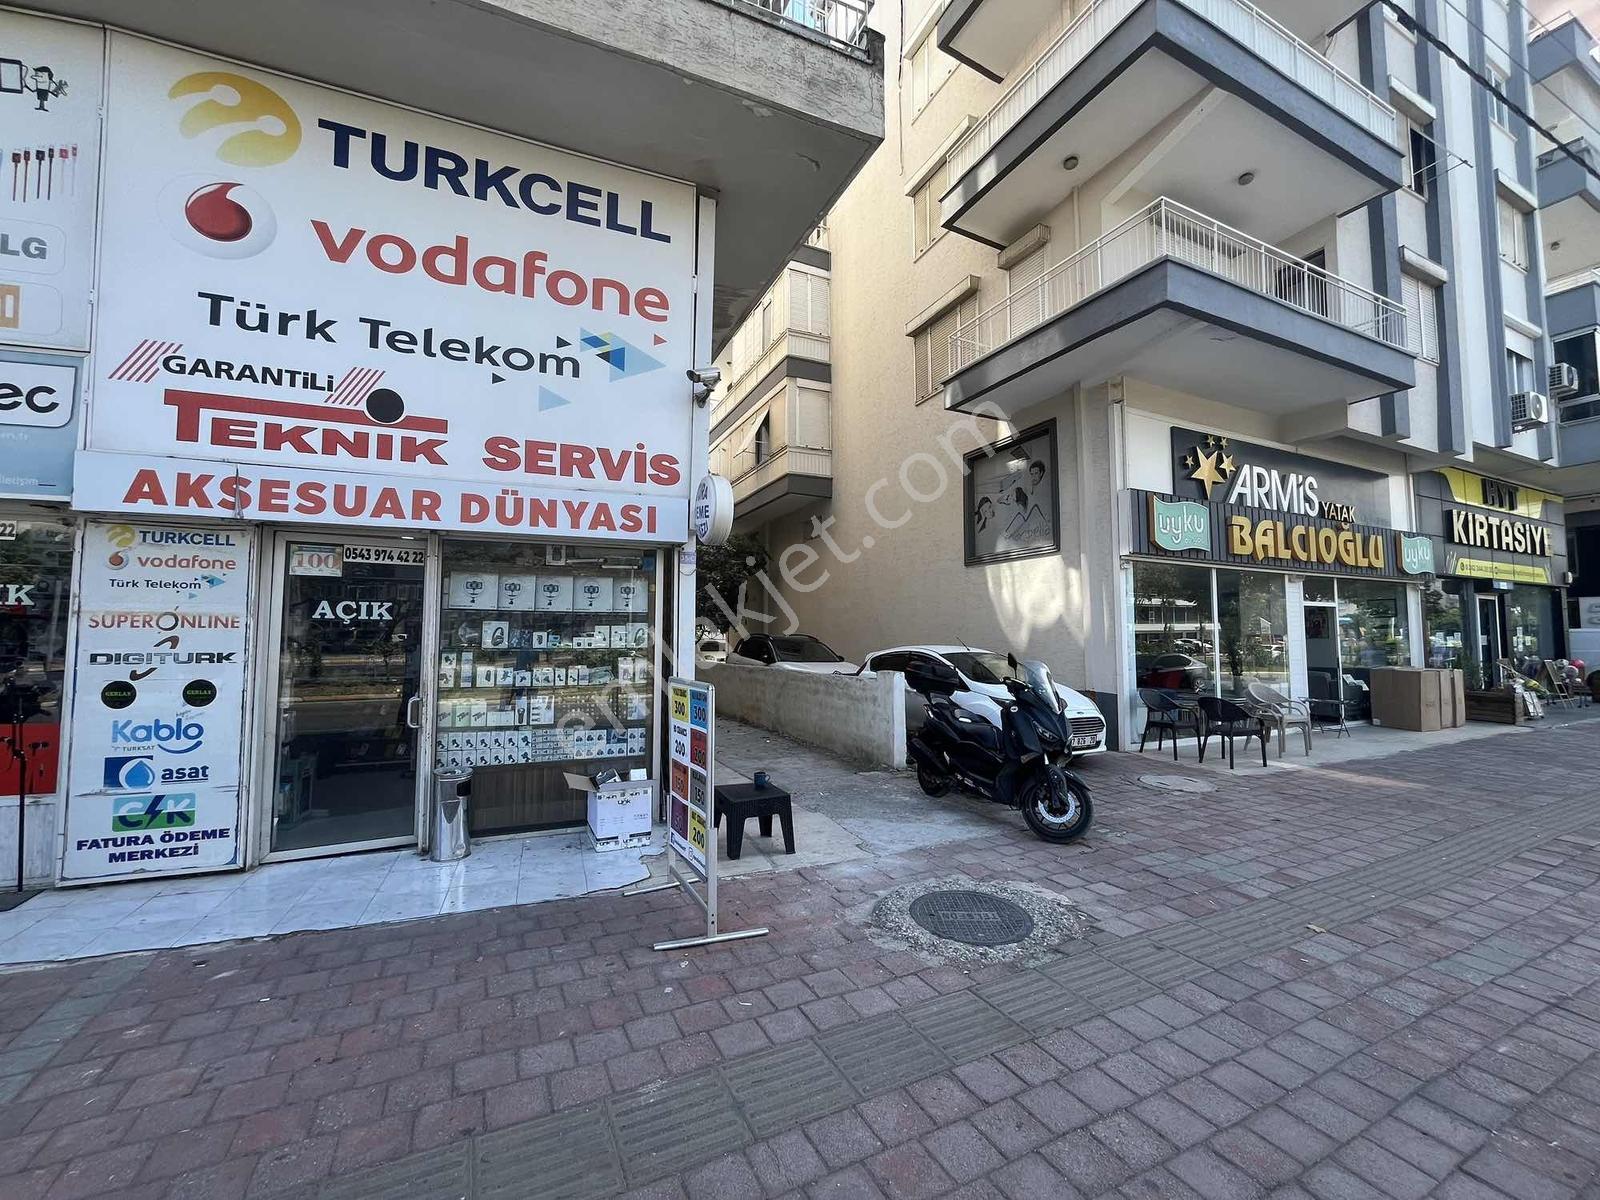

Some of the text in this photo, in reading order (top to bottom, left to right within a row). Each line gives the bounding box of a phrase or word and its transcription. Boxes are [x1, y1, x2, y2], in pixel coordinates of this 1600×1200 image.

[318, 118, 671, 243] TURKCELL
[0, 233, 48, 260] LG
[310, 220, 670, 322] vodafone
[198, 291, 580, 378] Türk Telekom
[482, 436, 681, 486] SERVİS
[122, 469, 657, 534] AKSESUAR DÜNYASI
[1321, 501, 1356, 523] YATAK
[1159, 505, 1204, 544] uyku
[1452, 509, 1553, 557] KIRTASİYE
[139, 530, 236, 546] TURKCELL
[1231, 515, 1384, 569] BALCIOĞLU
[137, 554, 237, 570] vodafone
[292, 552, 342, 569] 100
[344, 549, 424, 564] 0543 974 42 22
[109, 578, 201, 589] Türk Telekom
[88, 612, 240, 632] SUPERONLINE
[312, 600, 393, 624] AÇIK
[674, 700, 686, 716] 300
[693, 705, 707, 722] 300
[111, 718, 204, 743] Kablo
[161, 765, 209, 780] asat
[77, 828, 230, 850] FATURA ÖDEME
[693, 827, 705, 849] 200
[108, 844, 199, 863] MERKEZİ
